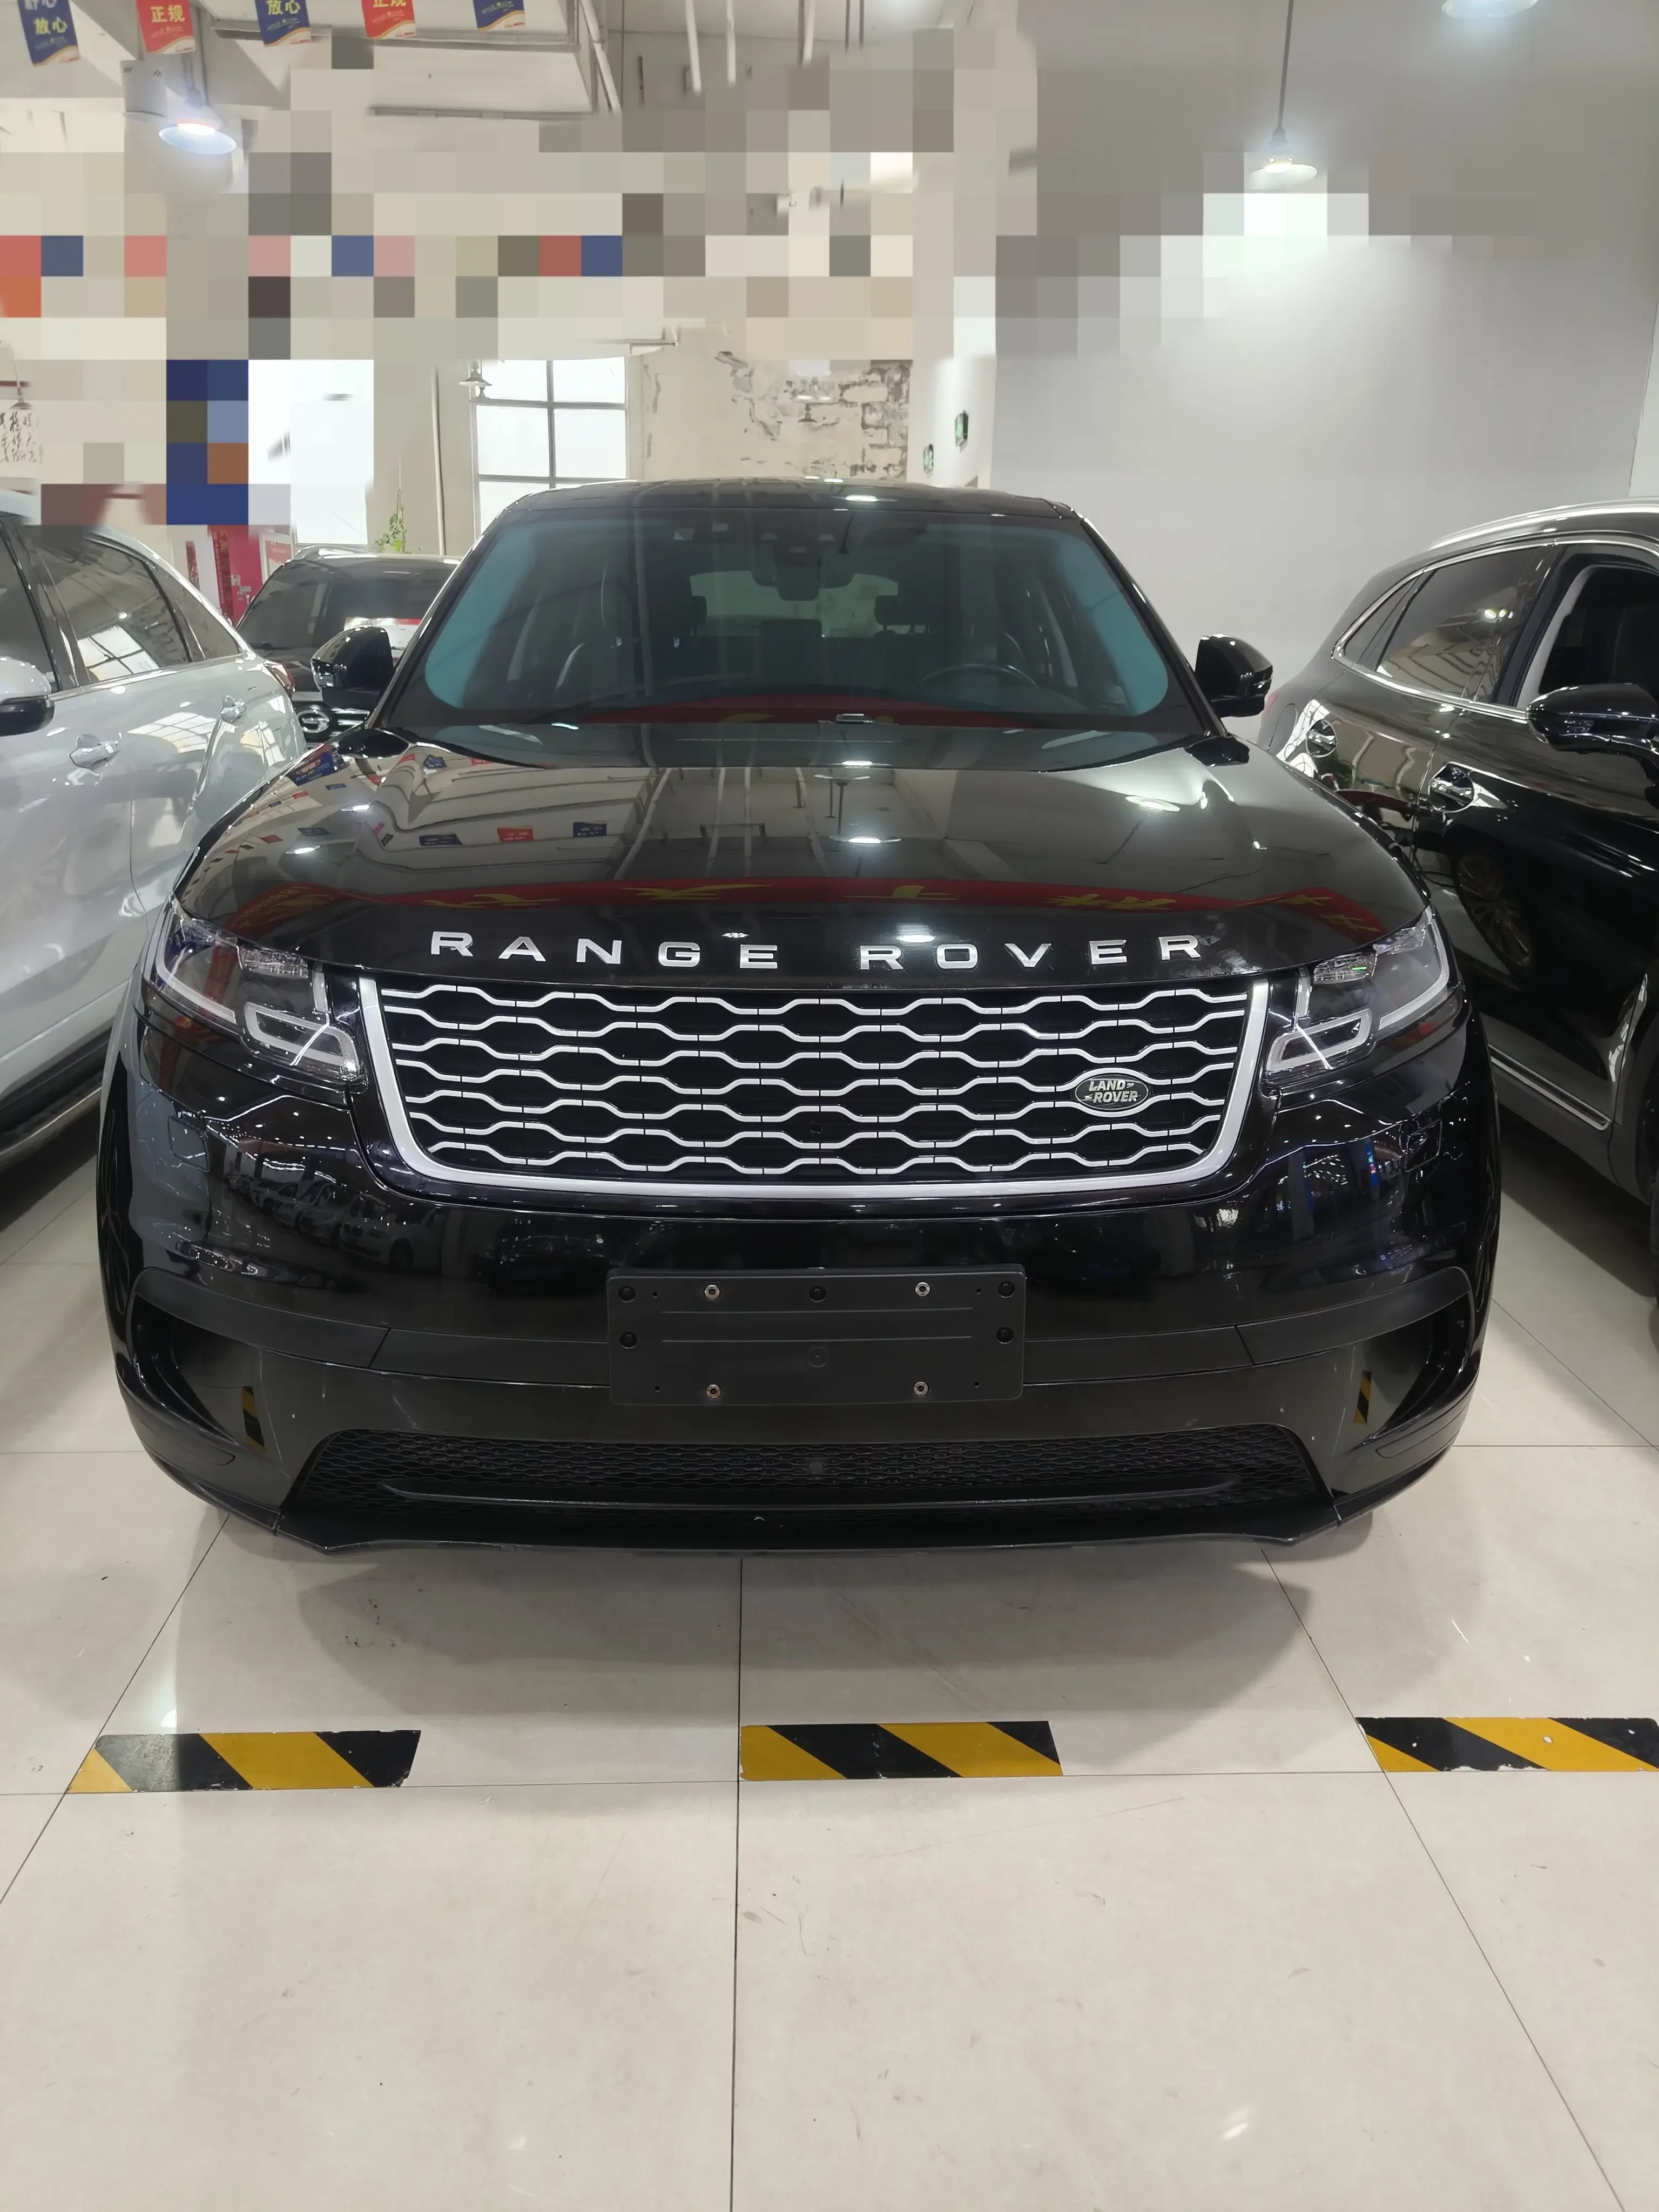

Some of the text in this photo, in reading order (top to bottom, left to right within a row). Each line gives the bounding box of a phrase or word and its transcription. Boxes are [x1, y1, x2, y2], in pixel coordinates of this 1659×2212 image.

[150, 5, 185, 22] 正规
[266, 0, 301, 15] 放心
[33, 17, 68, 35] 放心
[431, 931, 1201, 970] RANGE ROVER
[1089, 1080, 1126, 1091] LAND
[1092, 1091, 1138, 1103] ROVER
